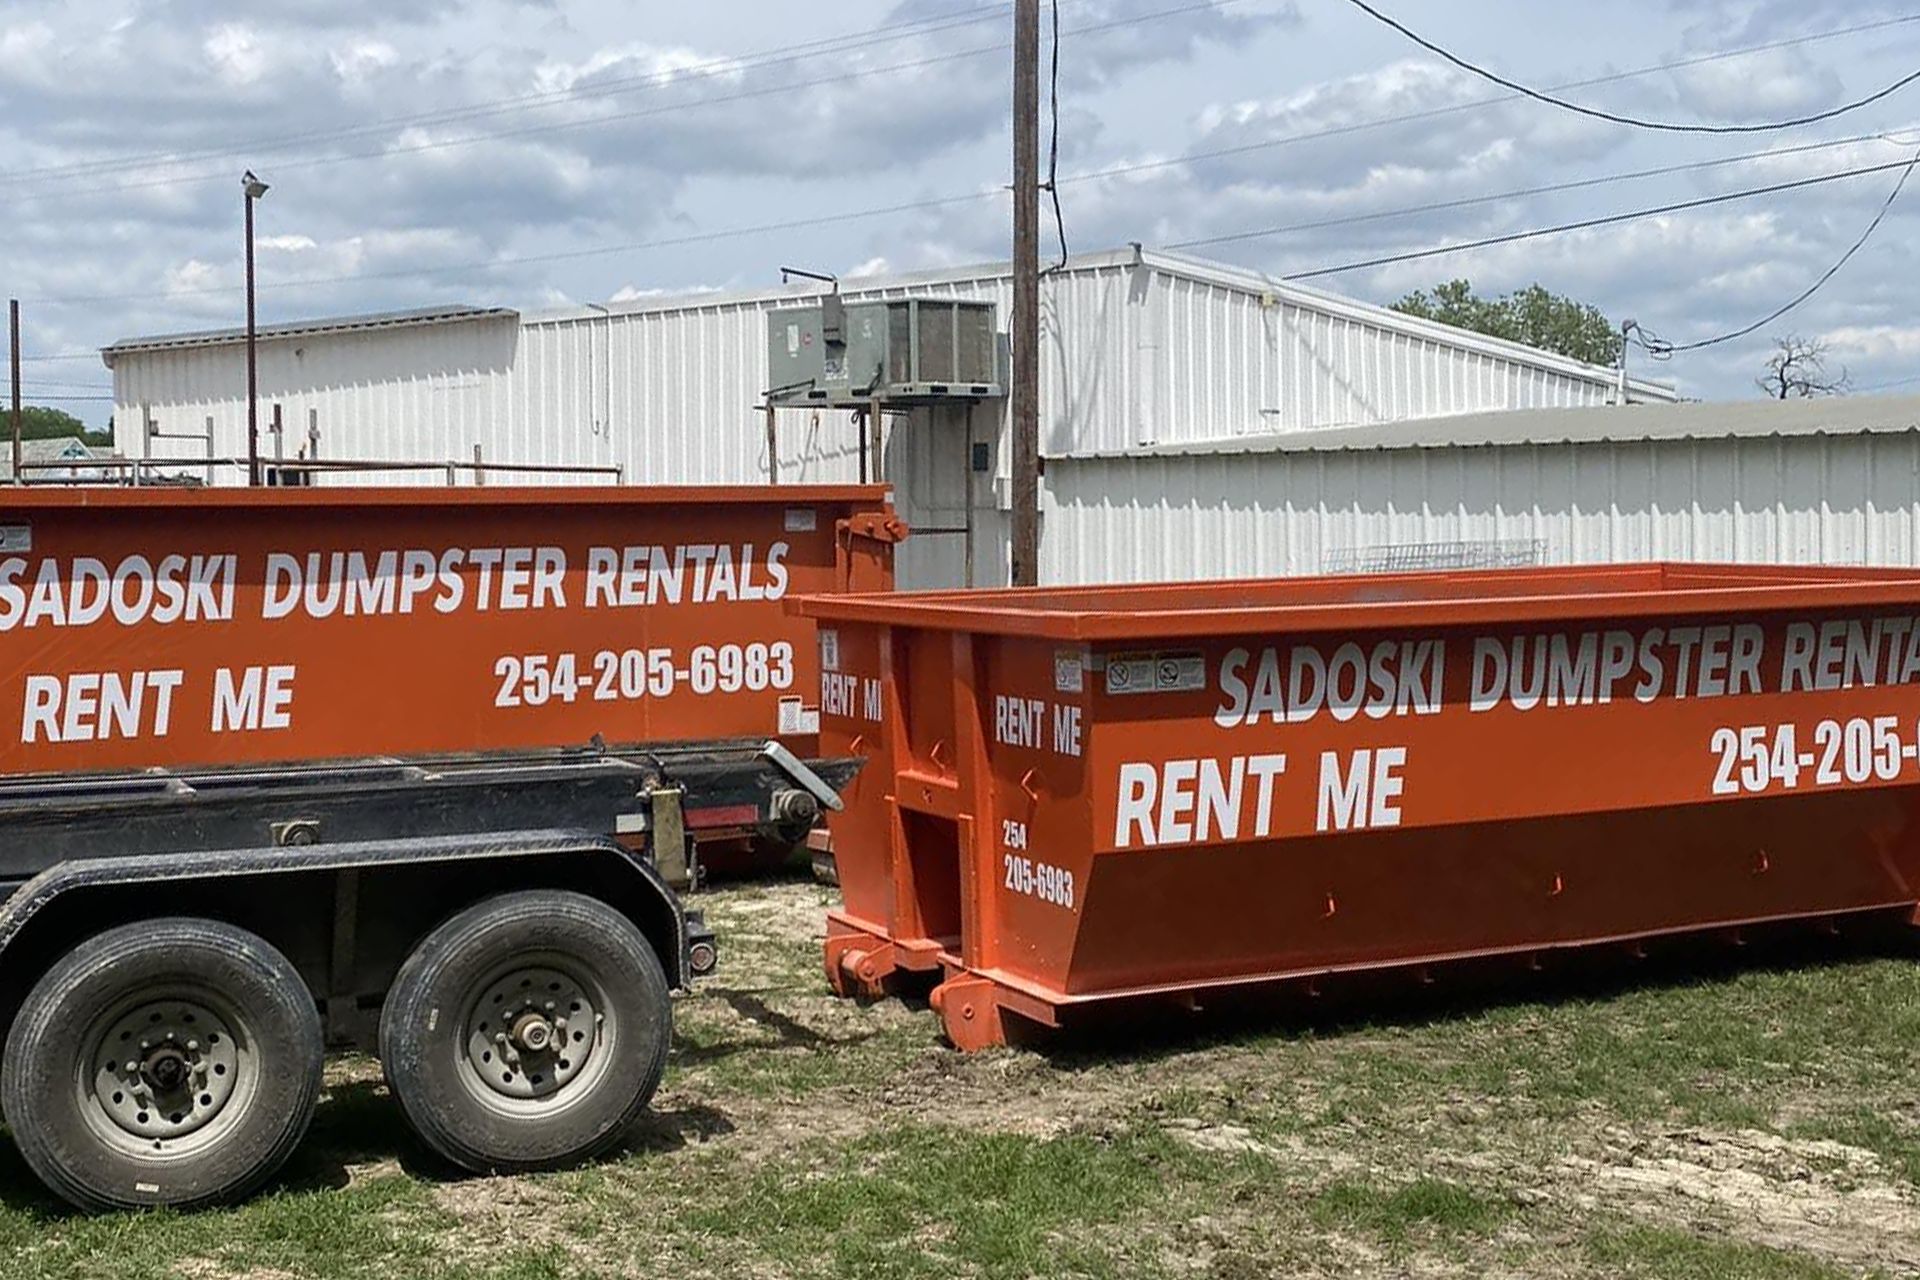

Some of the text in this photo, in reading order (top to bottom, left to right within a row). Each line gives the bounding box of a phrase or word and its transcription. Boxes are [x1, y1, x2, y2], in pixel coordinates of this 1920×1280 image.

[0, 542, 789, 631] SADOSKI DUMPSTER RENTALS
[22, 666, 296, 743] RENT ME
[494, 642, 794, 708] 254-205-6983
[822, 672, 857, 718] RENT
[1214, 641, 1445, 728] SADOSKI
[1470, 625, 1763, 711] DUMPSTER
[996, 696, 1082, 756] RENT ME
[1710, 717, 1920, 795] 254-205-
[1115, 747, 1406, 848] RENT ME
[1003, 820, 1026, 850] 254
[1005, 854, 1073, 908] 205-6983
